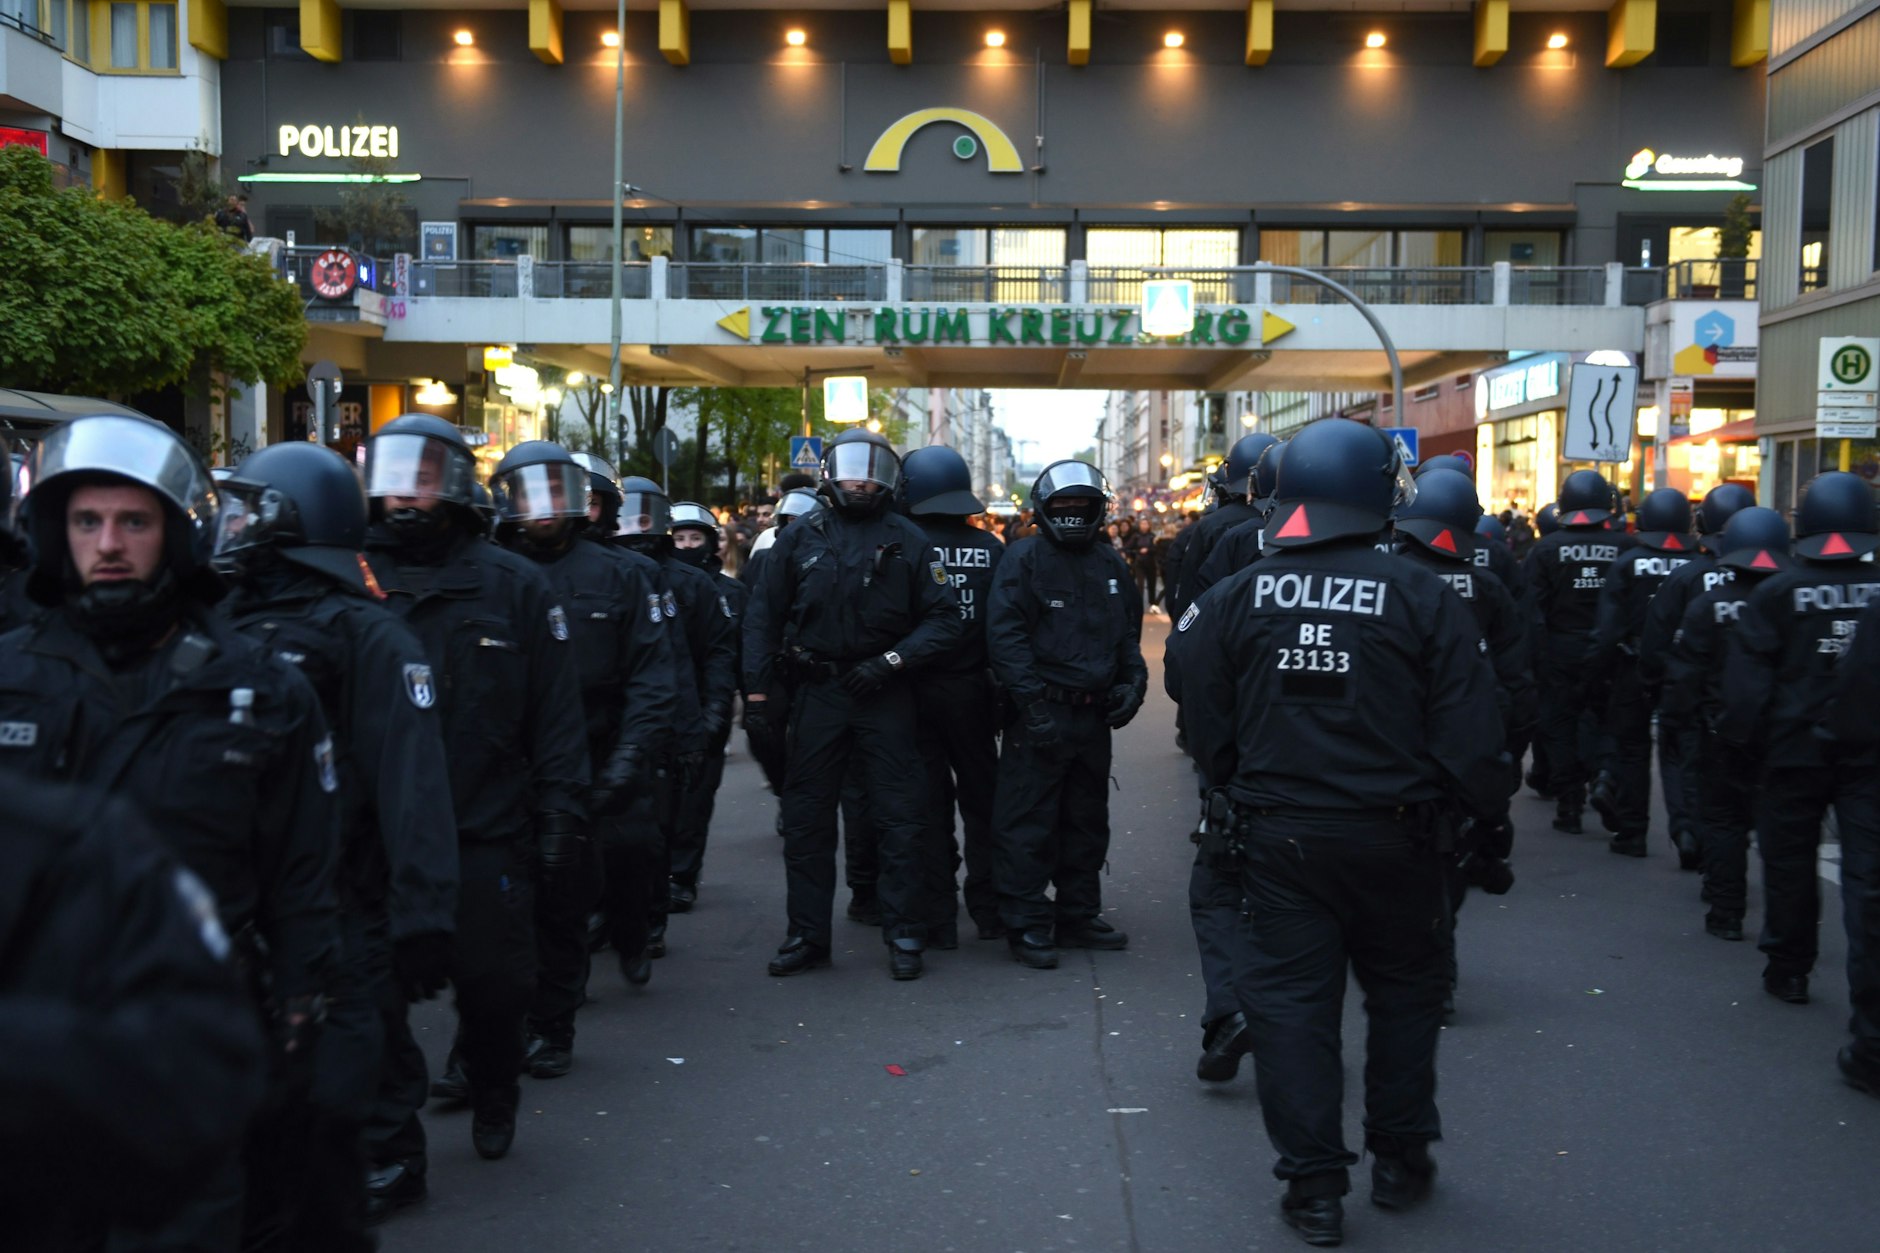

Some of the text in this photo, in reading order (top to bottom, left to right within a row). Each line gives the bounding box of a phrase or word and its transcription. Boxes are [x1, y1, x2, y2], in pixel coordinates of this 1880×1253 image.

[279, 124, 399, 158] POLIZEI
[761, 307, 1250, 345] ZENTRUM KREUZRG
[1559, 545, 1618, 562] POLIZEI
[1581, 567, 1598, 577] BE
[1254, 573, 1387, 616] POLIZEI
[1299, 623, 1333, 646] BE
[1277, 648, 1350, 673] 23133
